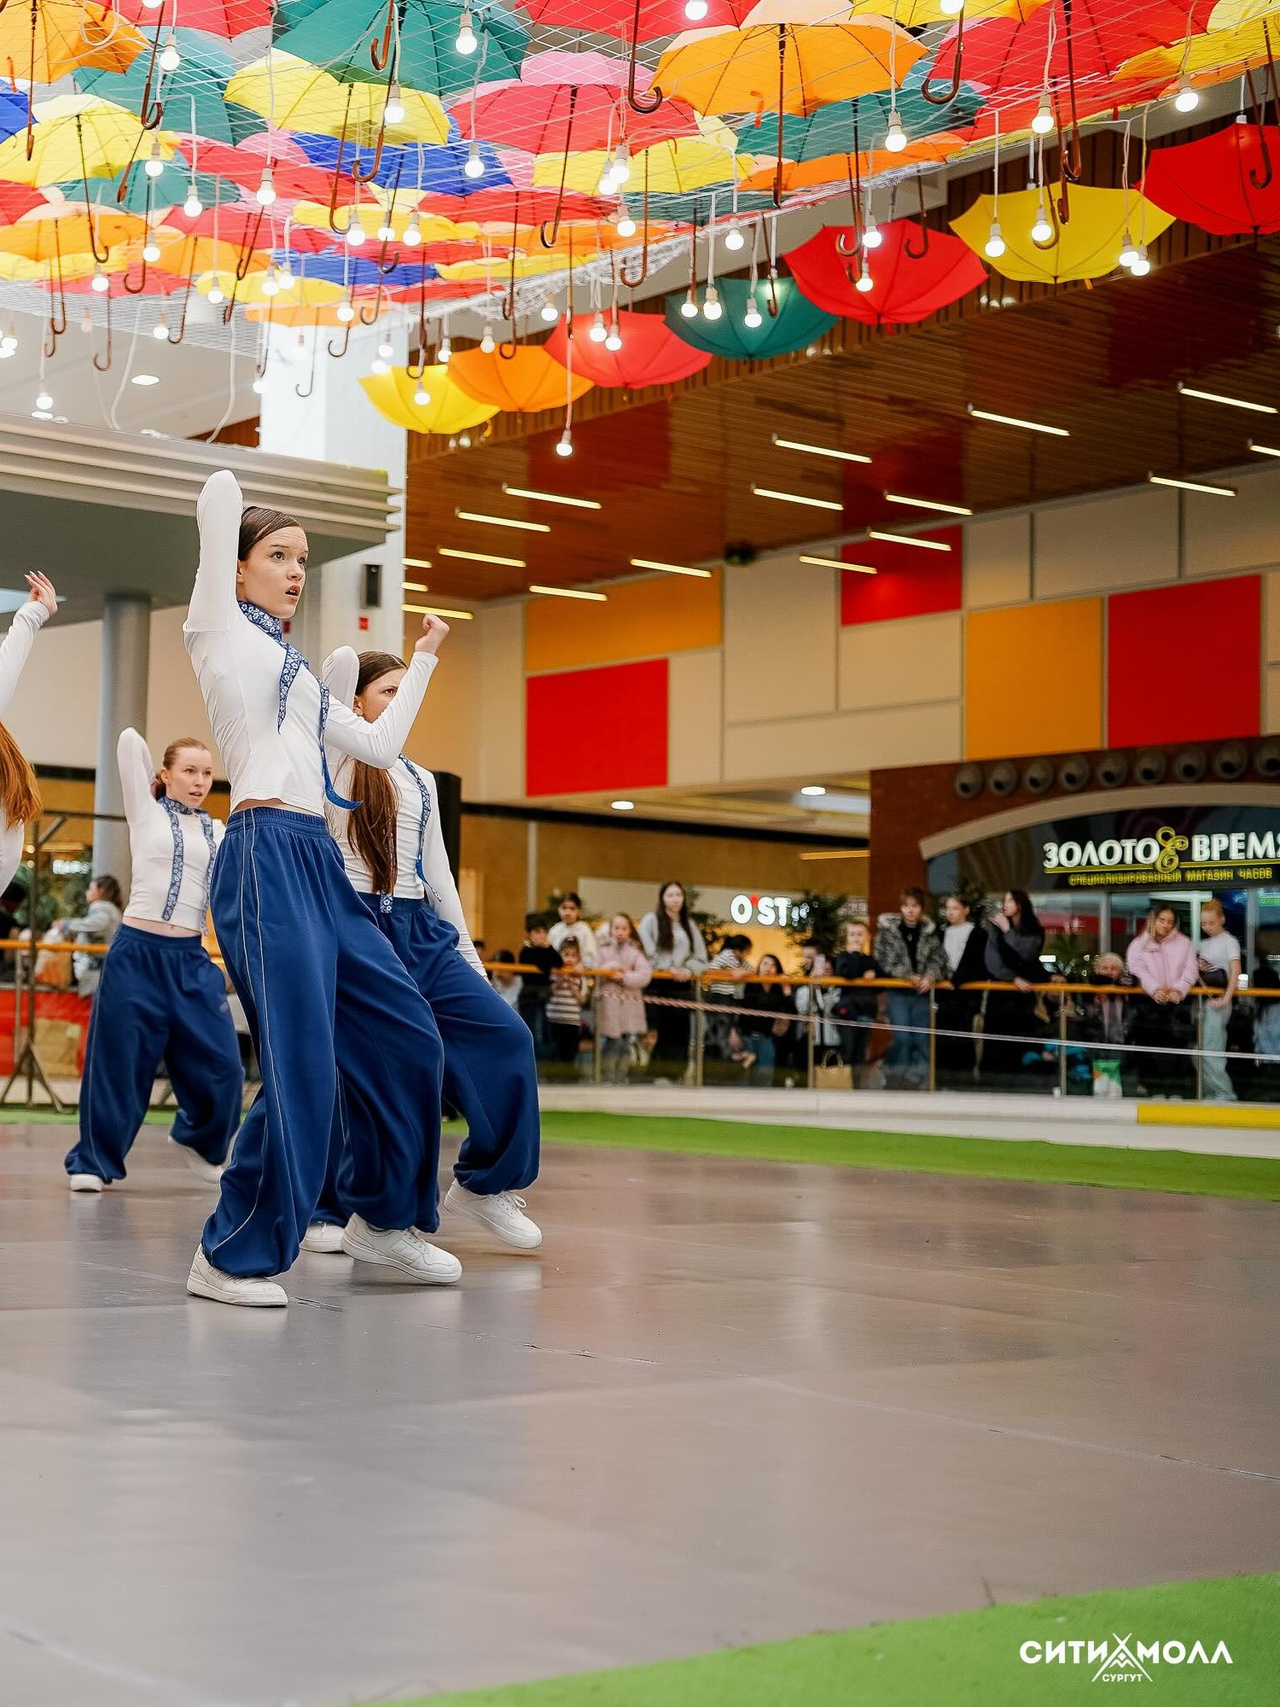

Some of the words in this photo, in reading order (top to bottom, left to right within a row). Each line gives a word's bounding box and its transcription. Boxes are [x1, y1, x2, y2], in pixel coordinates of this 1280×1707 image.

[1042, 836, 1160, 869] ЗОЛОТО
[1191, 831, 1280, 862] ВРЕМ
[1185, 871, 1234, 883] МАГАЗИН
[1239, 867, 1273, 880] ЧАСОВ
